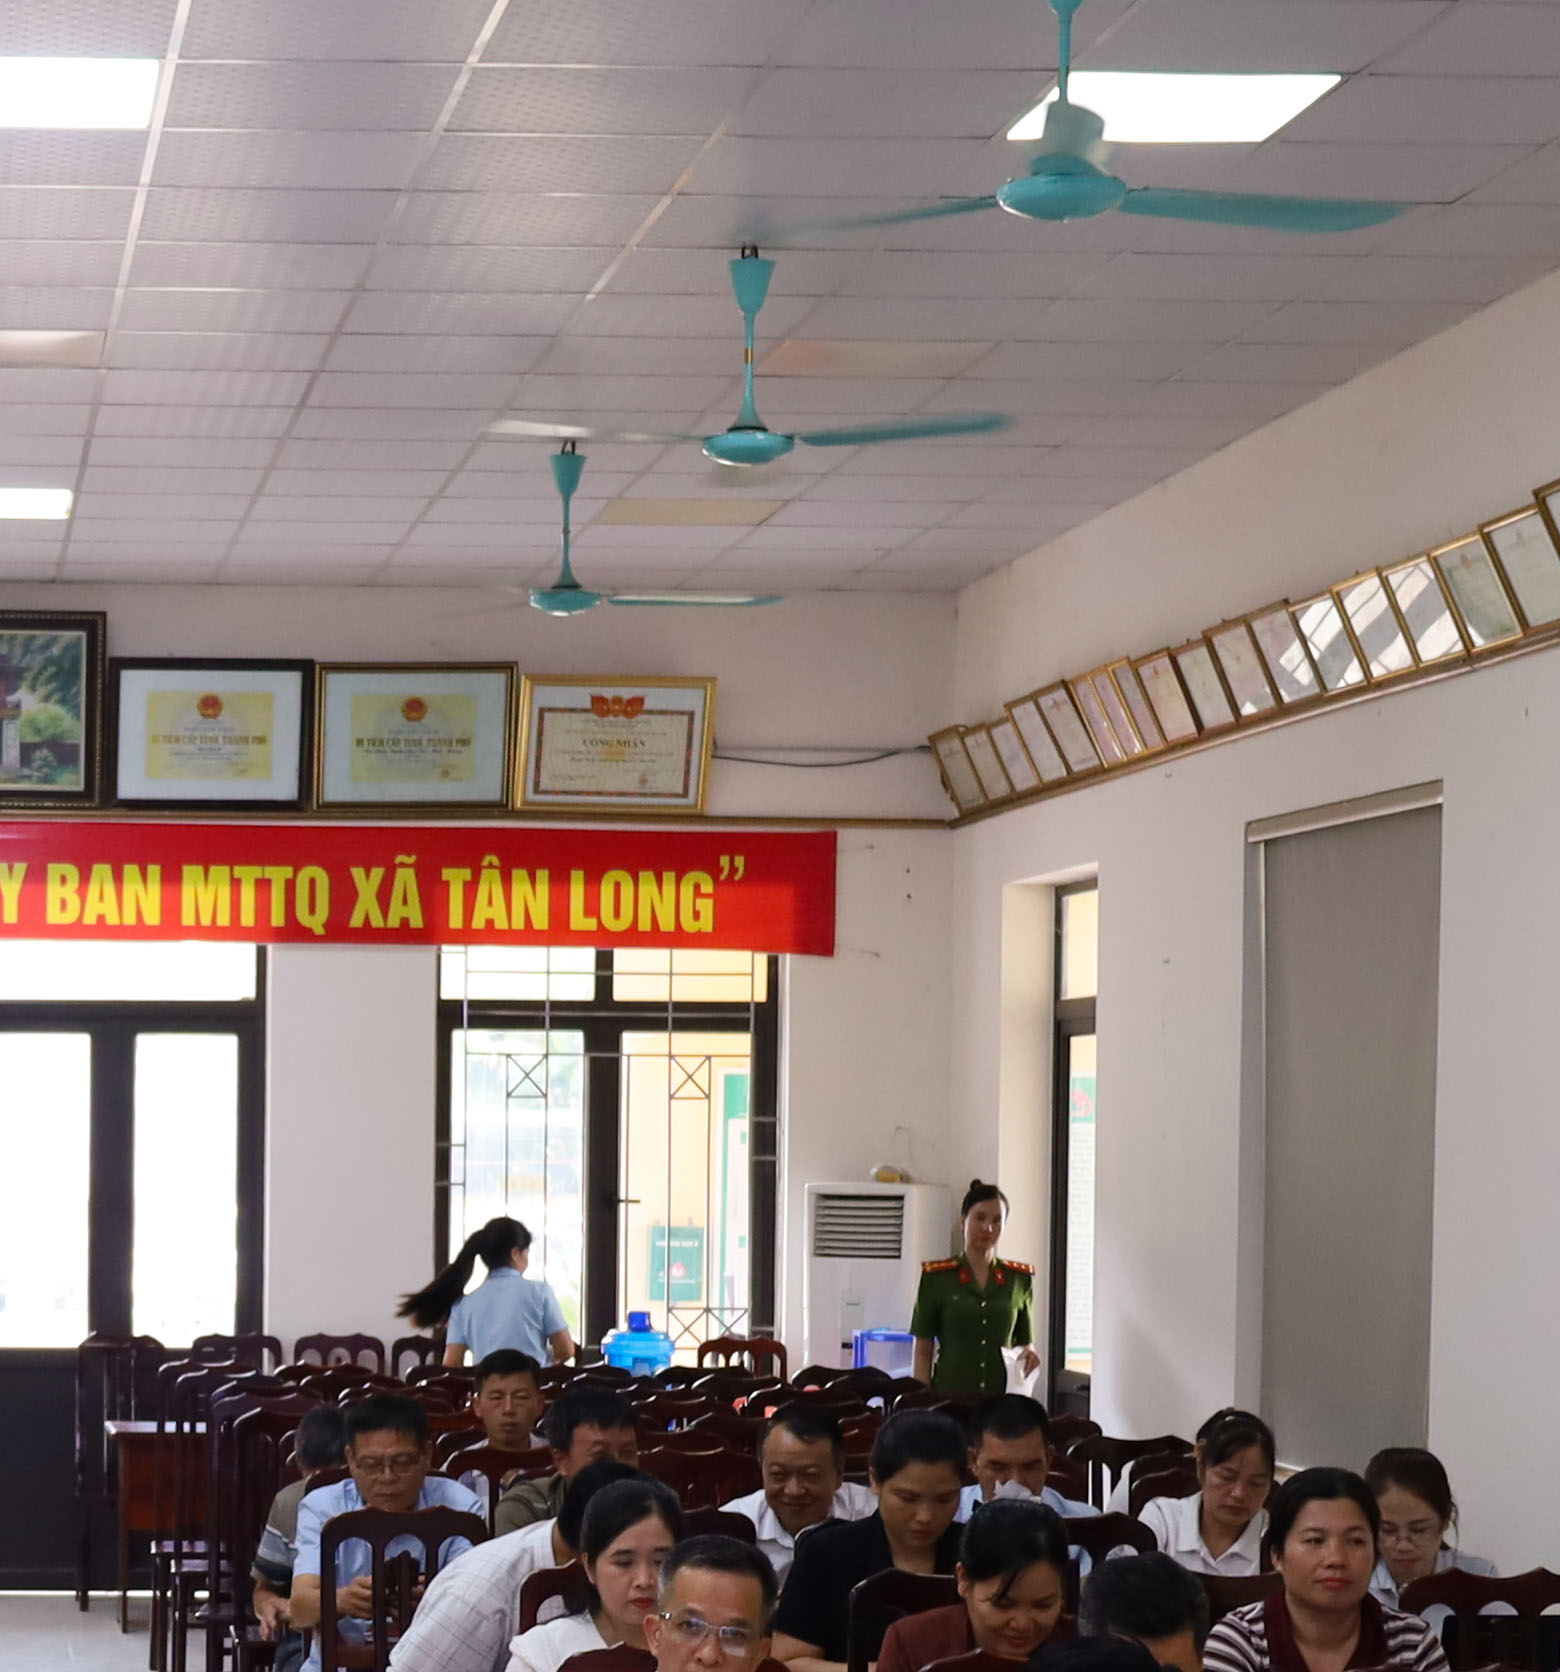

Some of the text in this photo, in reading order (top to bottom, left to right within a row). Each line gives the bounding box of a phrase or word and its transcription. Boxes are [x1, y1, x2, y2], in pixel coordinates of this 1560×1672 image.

[46, 864, 162, 927] BAN
[181, 864, 331, 937] MTTQ
[349, 854, 423, 931] XÃ
[441, 854, 550, 932] TÂN
[569, 854, 746, 934] LONG”
